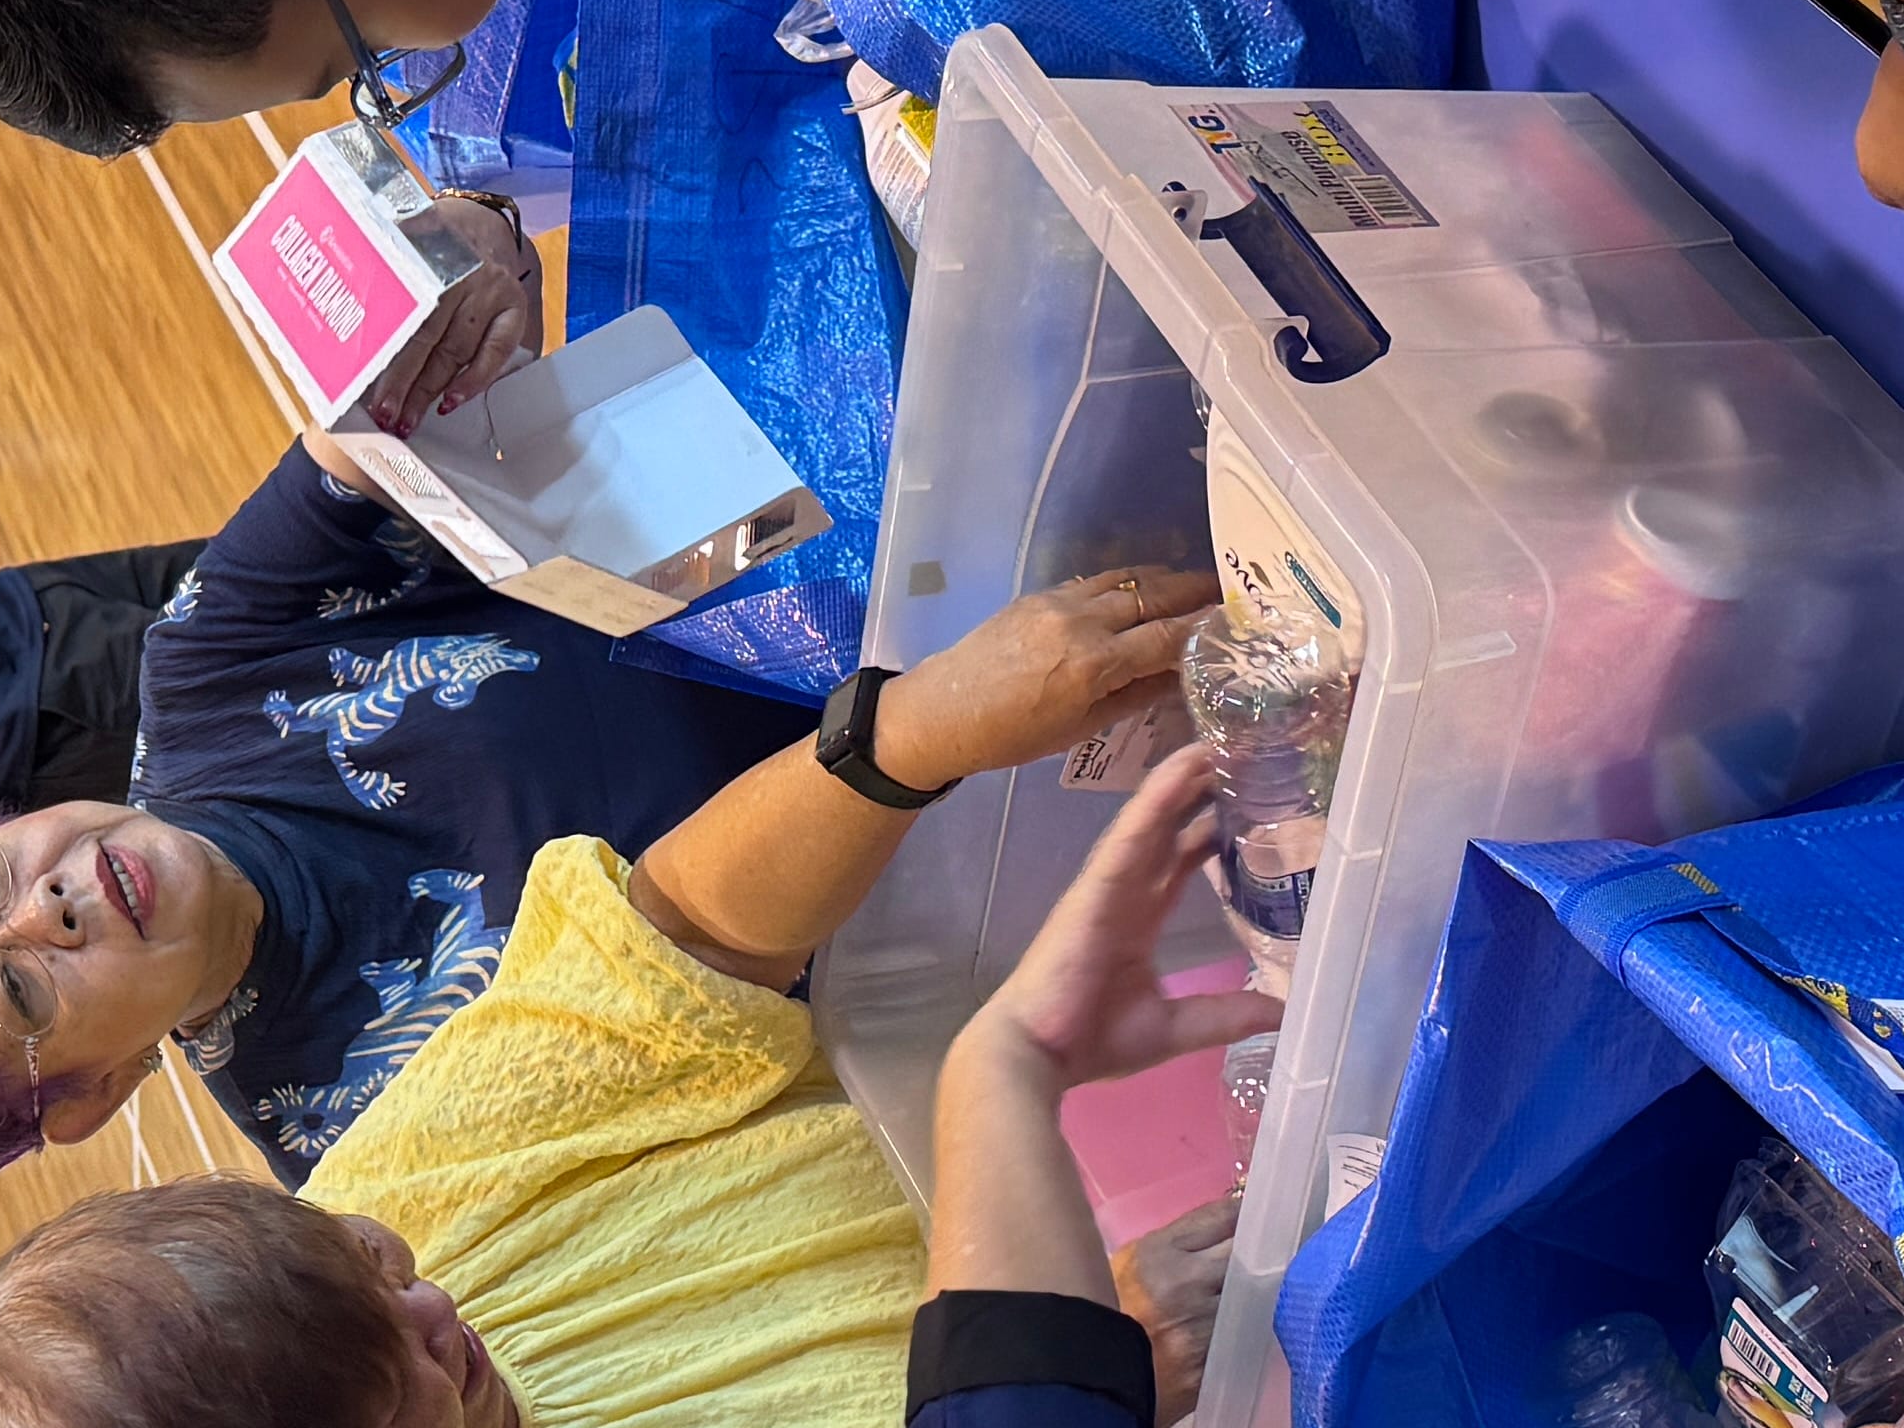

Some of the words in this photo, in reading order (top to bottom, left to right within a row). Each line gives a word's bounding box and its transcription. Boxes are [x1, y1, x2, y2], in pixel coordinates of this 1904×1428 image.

[1279, 130, 1351, 189] Purpose
[1292, 111, 1355, 165] BOX
[1330, 190, 1378, 227] Multi
[271, 214, 329, 290] COLLAGEN
[306, 266, 366, 343] DIAMOND
